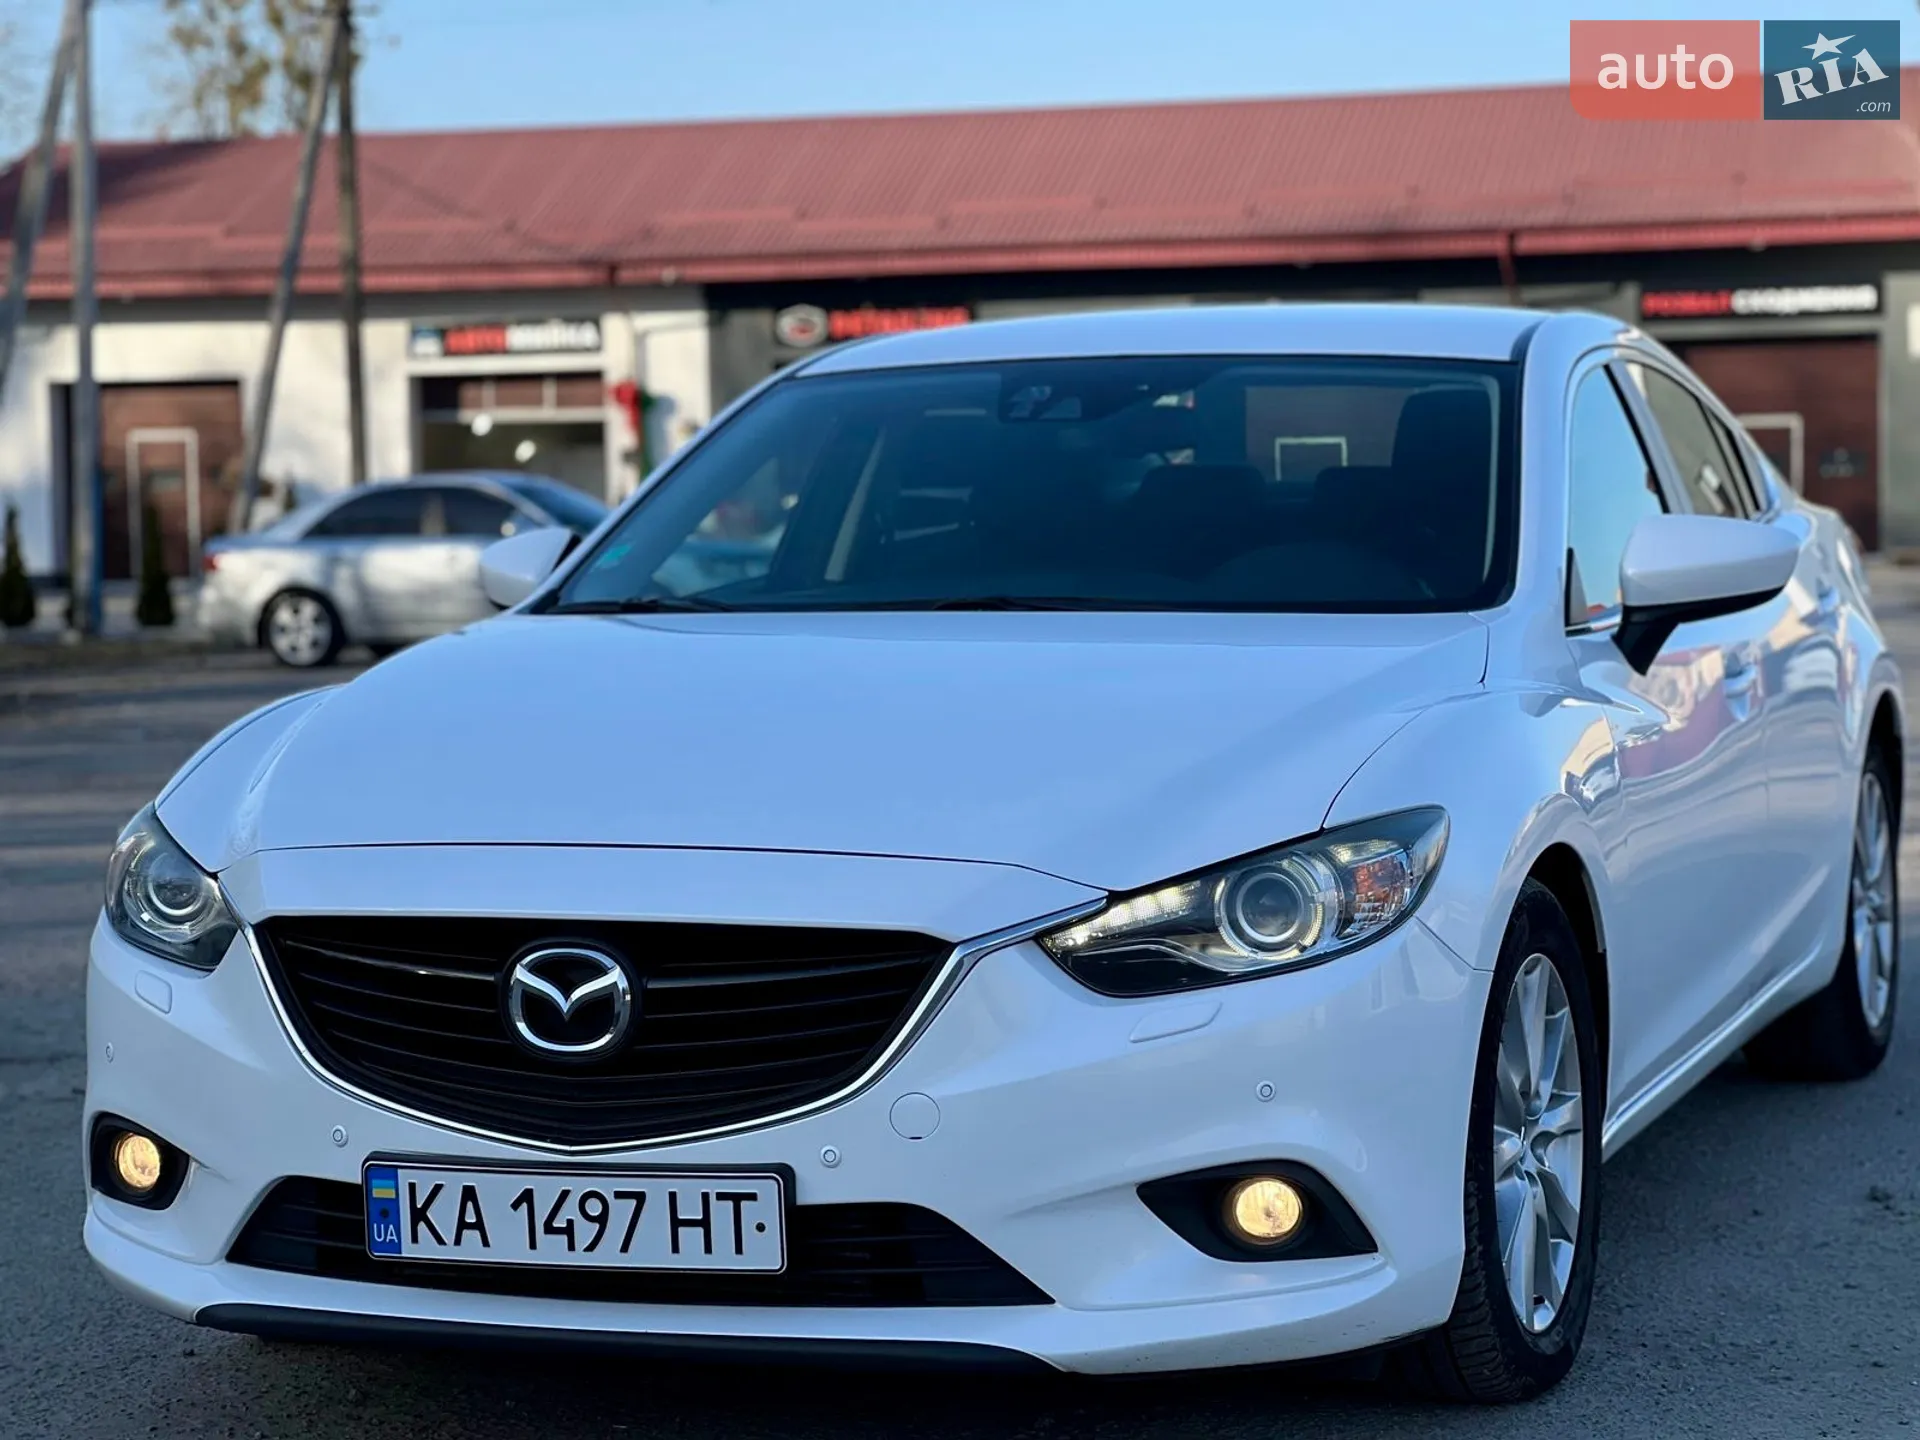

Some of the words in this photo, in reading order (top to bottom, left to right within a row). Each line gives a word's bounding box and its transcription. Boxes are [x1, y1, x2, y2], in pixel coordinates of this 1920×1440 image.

[373, 1223, 398, 1244] UA
[407, 1181, 490, 1248] KA
[510, 1187, 647, 1254] 1497
[669, 1189, 759, 1255] HT
